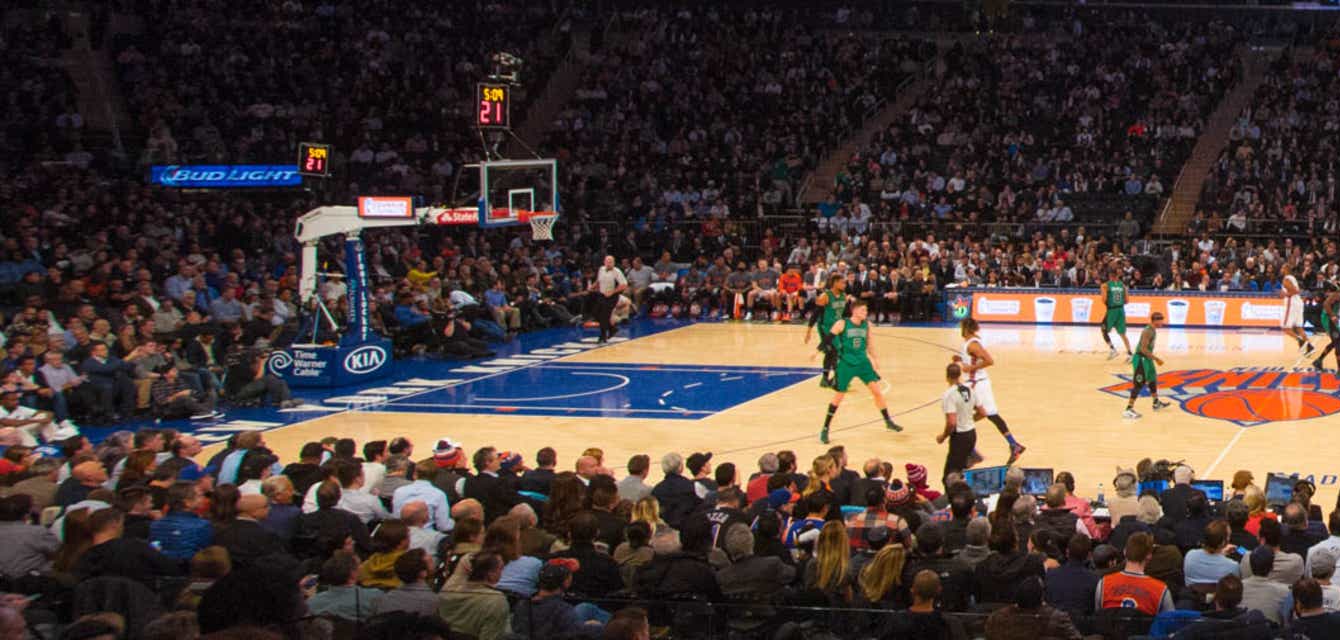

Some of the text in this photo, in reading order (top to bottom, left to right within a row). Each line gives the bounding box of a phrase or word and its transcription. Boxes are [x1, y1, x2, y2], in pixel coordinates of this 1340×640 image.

[480, 101, 501, 123] 21
[306, 158, 321, 170] 21
[227, 169, 299, 181] LIGHT
[293, 350, 317, 359] Time
[352, 350, 380, 370] KIA
[293, 360, 327, 369] Warner
[293, 368, 321, 377] Cable
